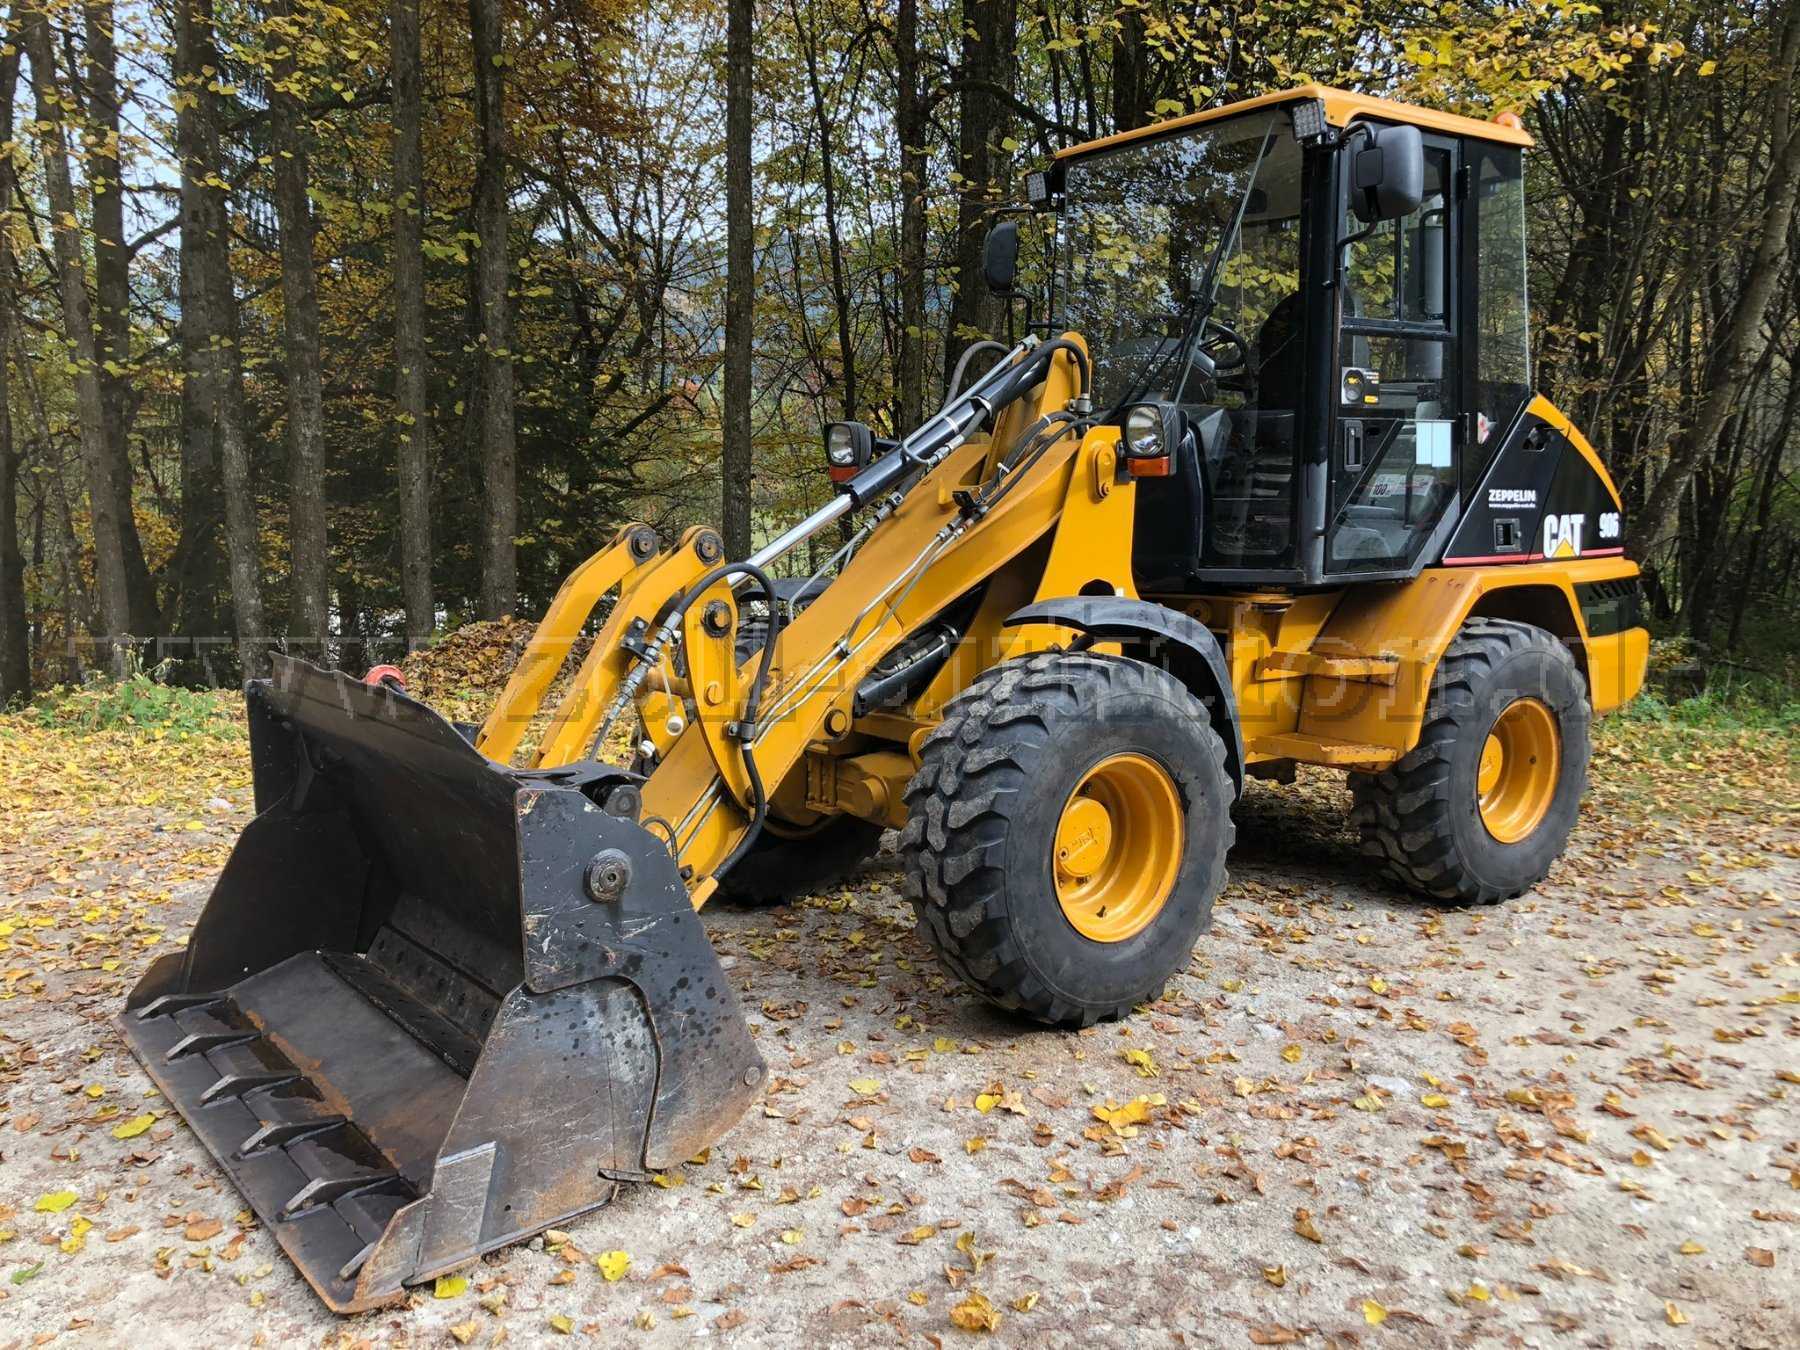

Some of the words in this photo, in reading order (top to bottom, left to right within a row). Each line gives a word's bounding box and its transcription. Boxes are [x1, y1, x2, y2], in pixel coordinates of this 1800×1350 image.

[1488, 489, 1537, 502] ZEPPELIN
[1543, 513, 1585, 559] CAT
[1599, 511, 1620, 538] 906
